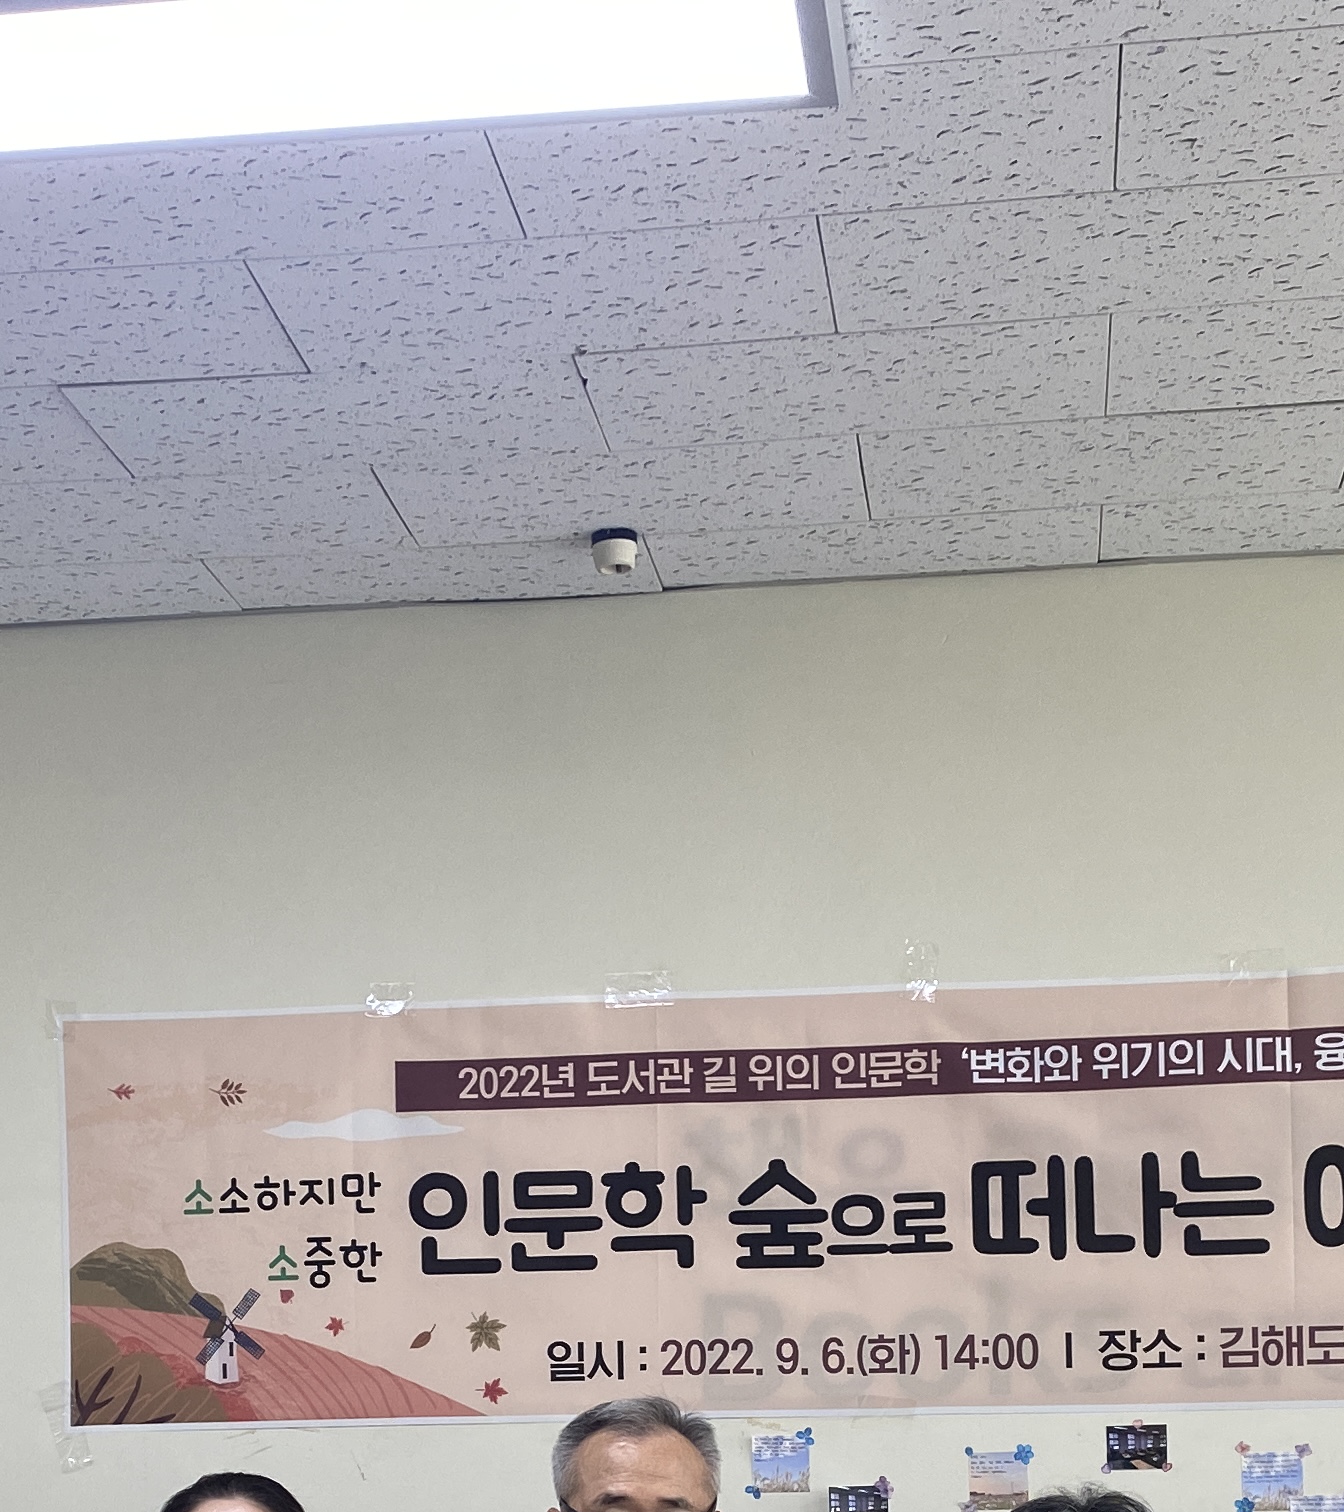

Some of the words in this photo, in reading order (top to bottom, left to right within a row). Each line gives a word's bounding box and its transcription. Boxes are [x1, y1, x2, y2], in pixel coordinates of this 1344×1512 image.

[458, 1060, 575, 1101] 2022년
[587, 1056, 693, 1098] 도서관
[701, 1053, 738, 1095] 길
[749, 1049, 821, 1092] 위의
[832, 1046, 941, 1089] 인문학
[1092, 1037, 1205, 1080] 위기의
[1217, 1030, 1304, 1076] 시대,
[184, 1170, 382, 1217] 소소하지만
[408, 1160, 708, 1275] 인문학
[729, 1158, 954, 1270] 숲으로
[971, 1150, 1275, 1261] 떠나는
[267, 1233, 383, 1287] 소중한
[547, 1338, 626, 1383] 일시
[660, 1339, 764, 1377] 2022.
[775, 1338, 809, 1375] 9.
[821, 1331, 922, 1379] 6.(화)
[934, 1333, 1039, 1372] 14:00
[1098, 1329, 1184, 1371] 장소
